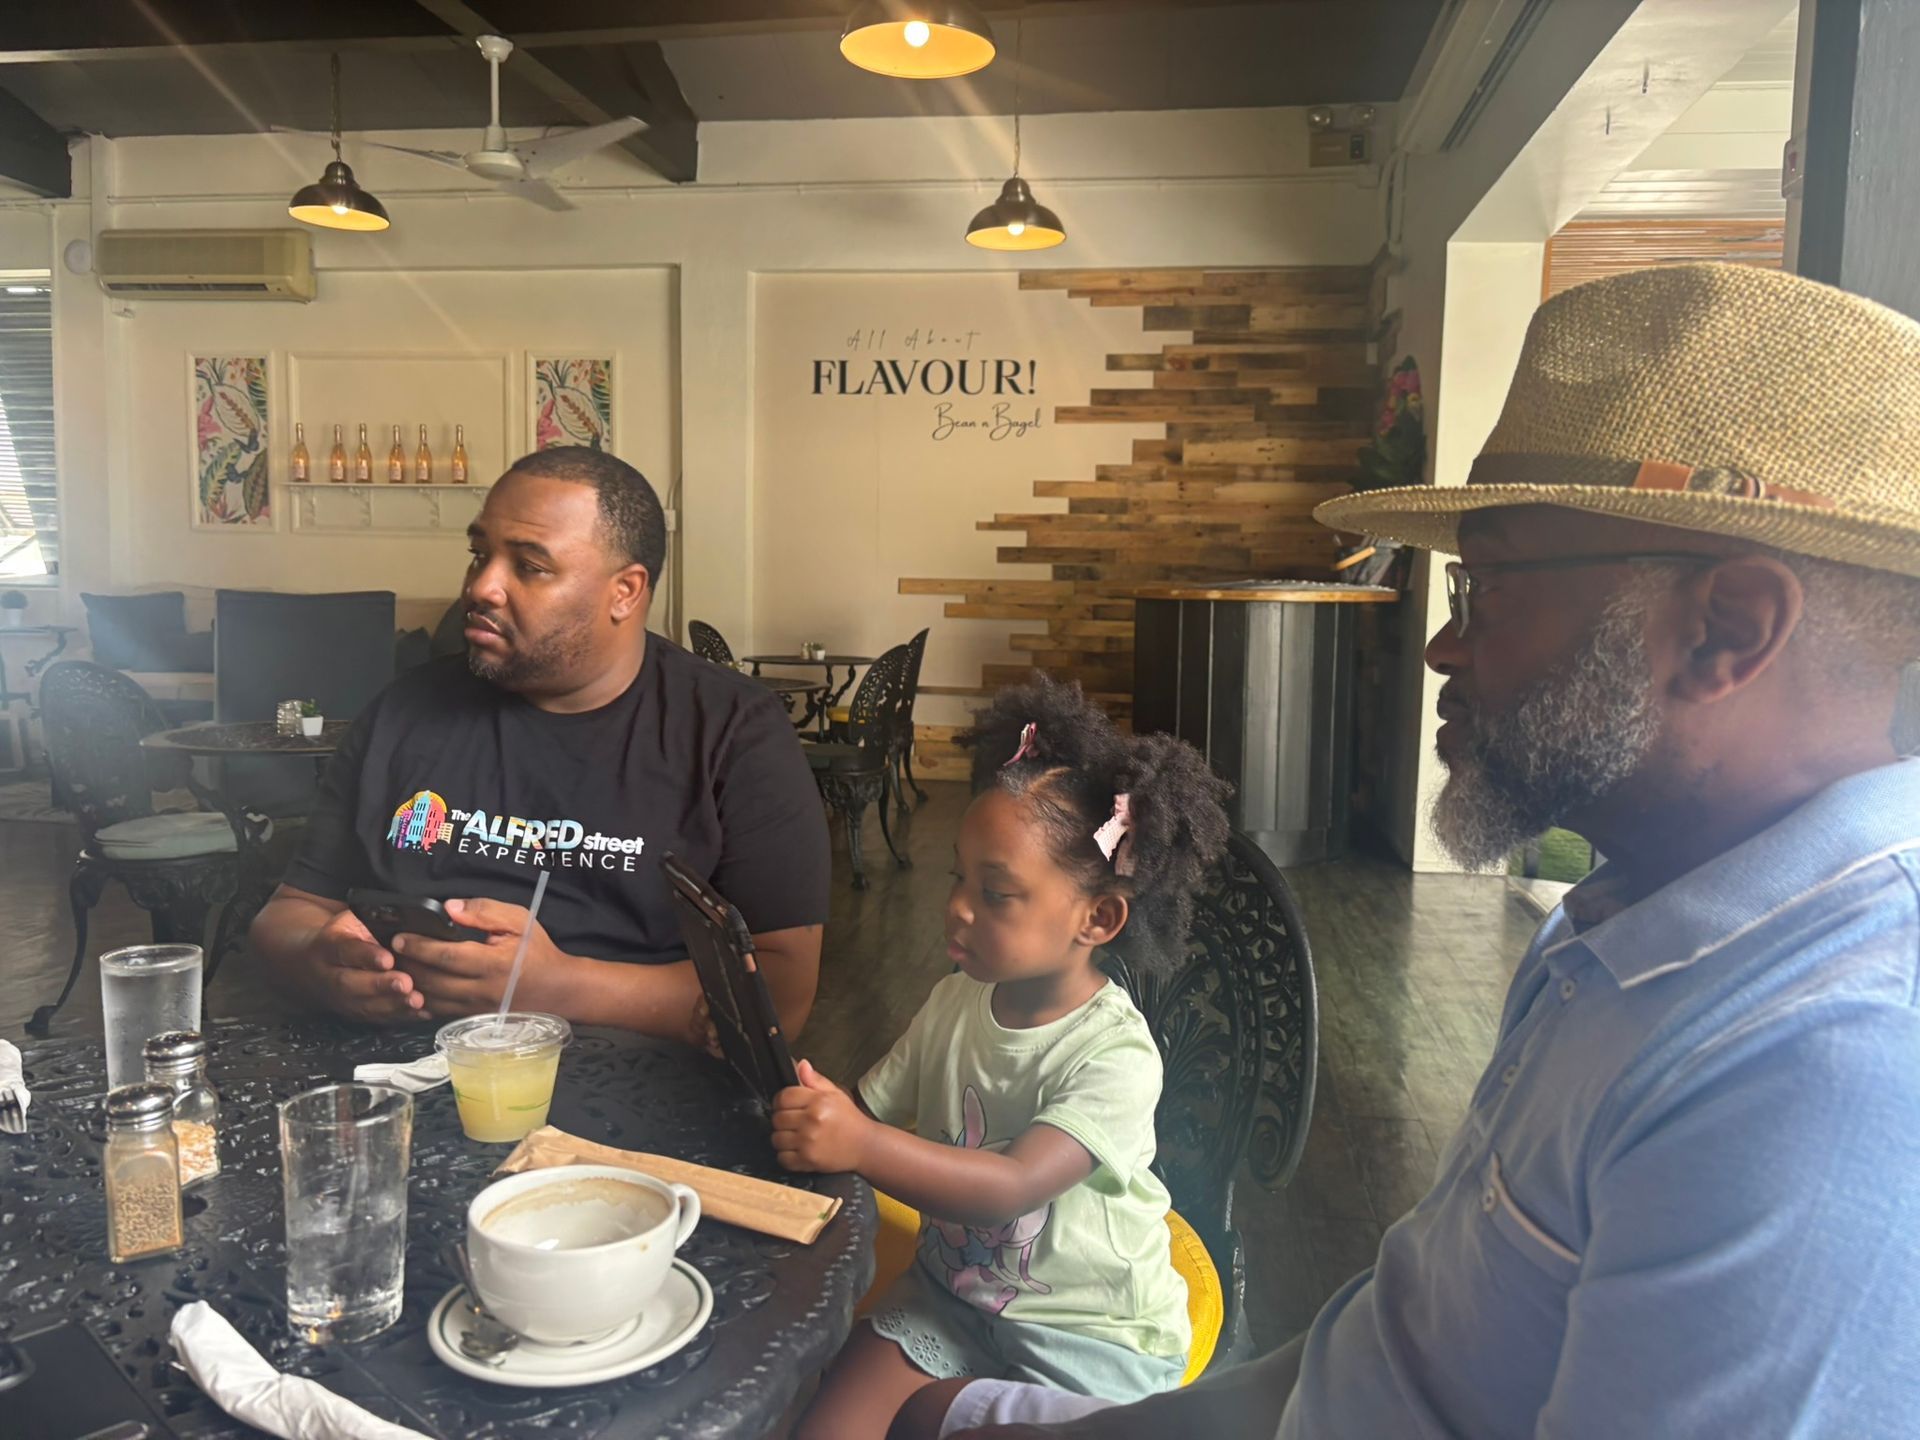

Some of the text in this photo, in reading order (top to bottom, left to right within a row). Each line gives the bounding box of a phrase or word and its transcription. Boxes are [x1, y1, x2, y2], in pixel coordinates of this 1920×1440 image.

[811, 359, 1037, 395] FLAVOUR!
[932, 402, 976, 441] Bean
[989, 402, 1041, 441] Bagel
[451, 809, 645, 855] The ALFRED street
[458, 838, 637, 872] EXPERIENCE
